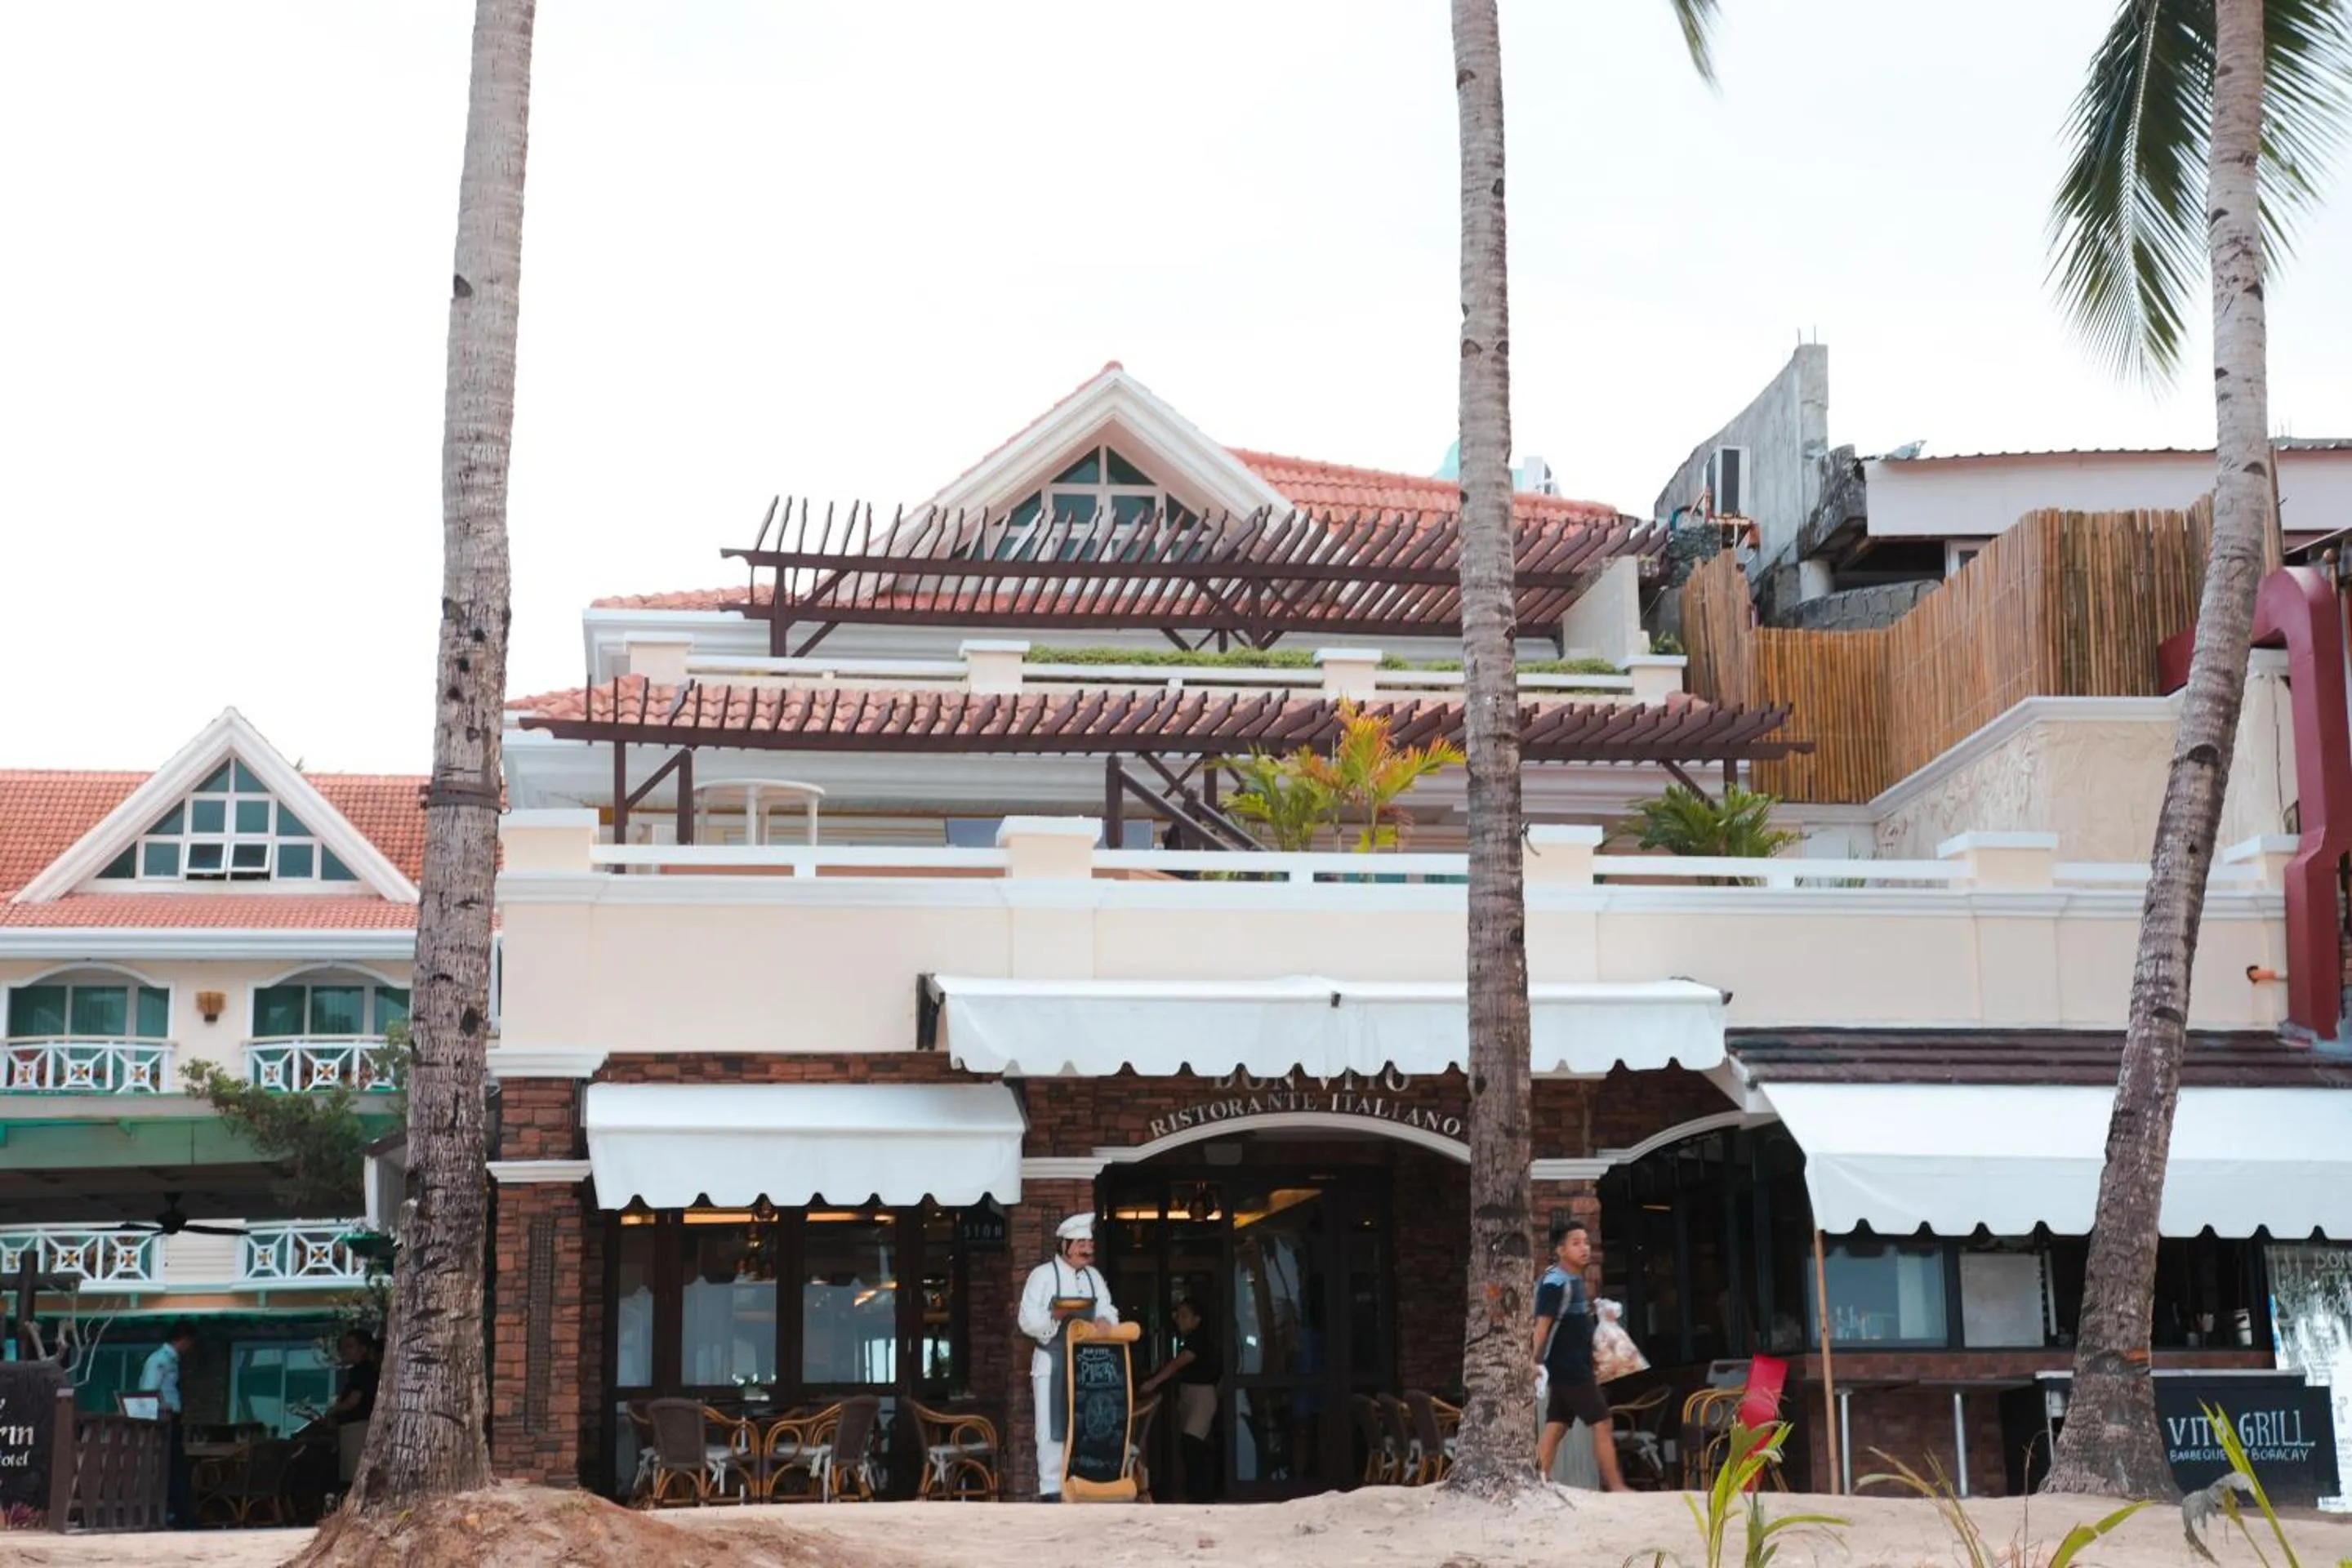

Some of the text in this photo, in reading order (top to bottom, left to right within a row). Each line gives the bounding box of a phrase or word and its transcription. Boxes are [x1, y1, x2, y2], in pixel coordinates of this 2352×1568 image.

[1149, 1092, 1462, 1138] RISTORANTE ITALIANO
[2238, 1409, 2316, 1447] GRILL
[0, 1450, 29, 1467] otel
[2169, 1448, 2227, 1463] BARBEQUE
[2252, 1447, 2310, 1462] BORACAY
